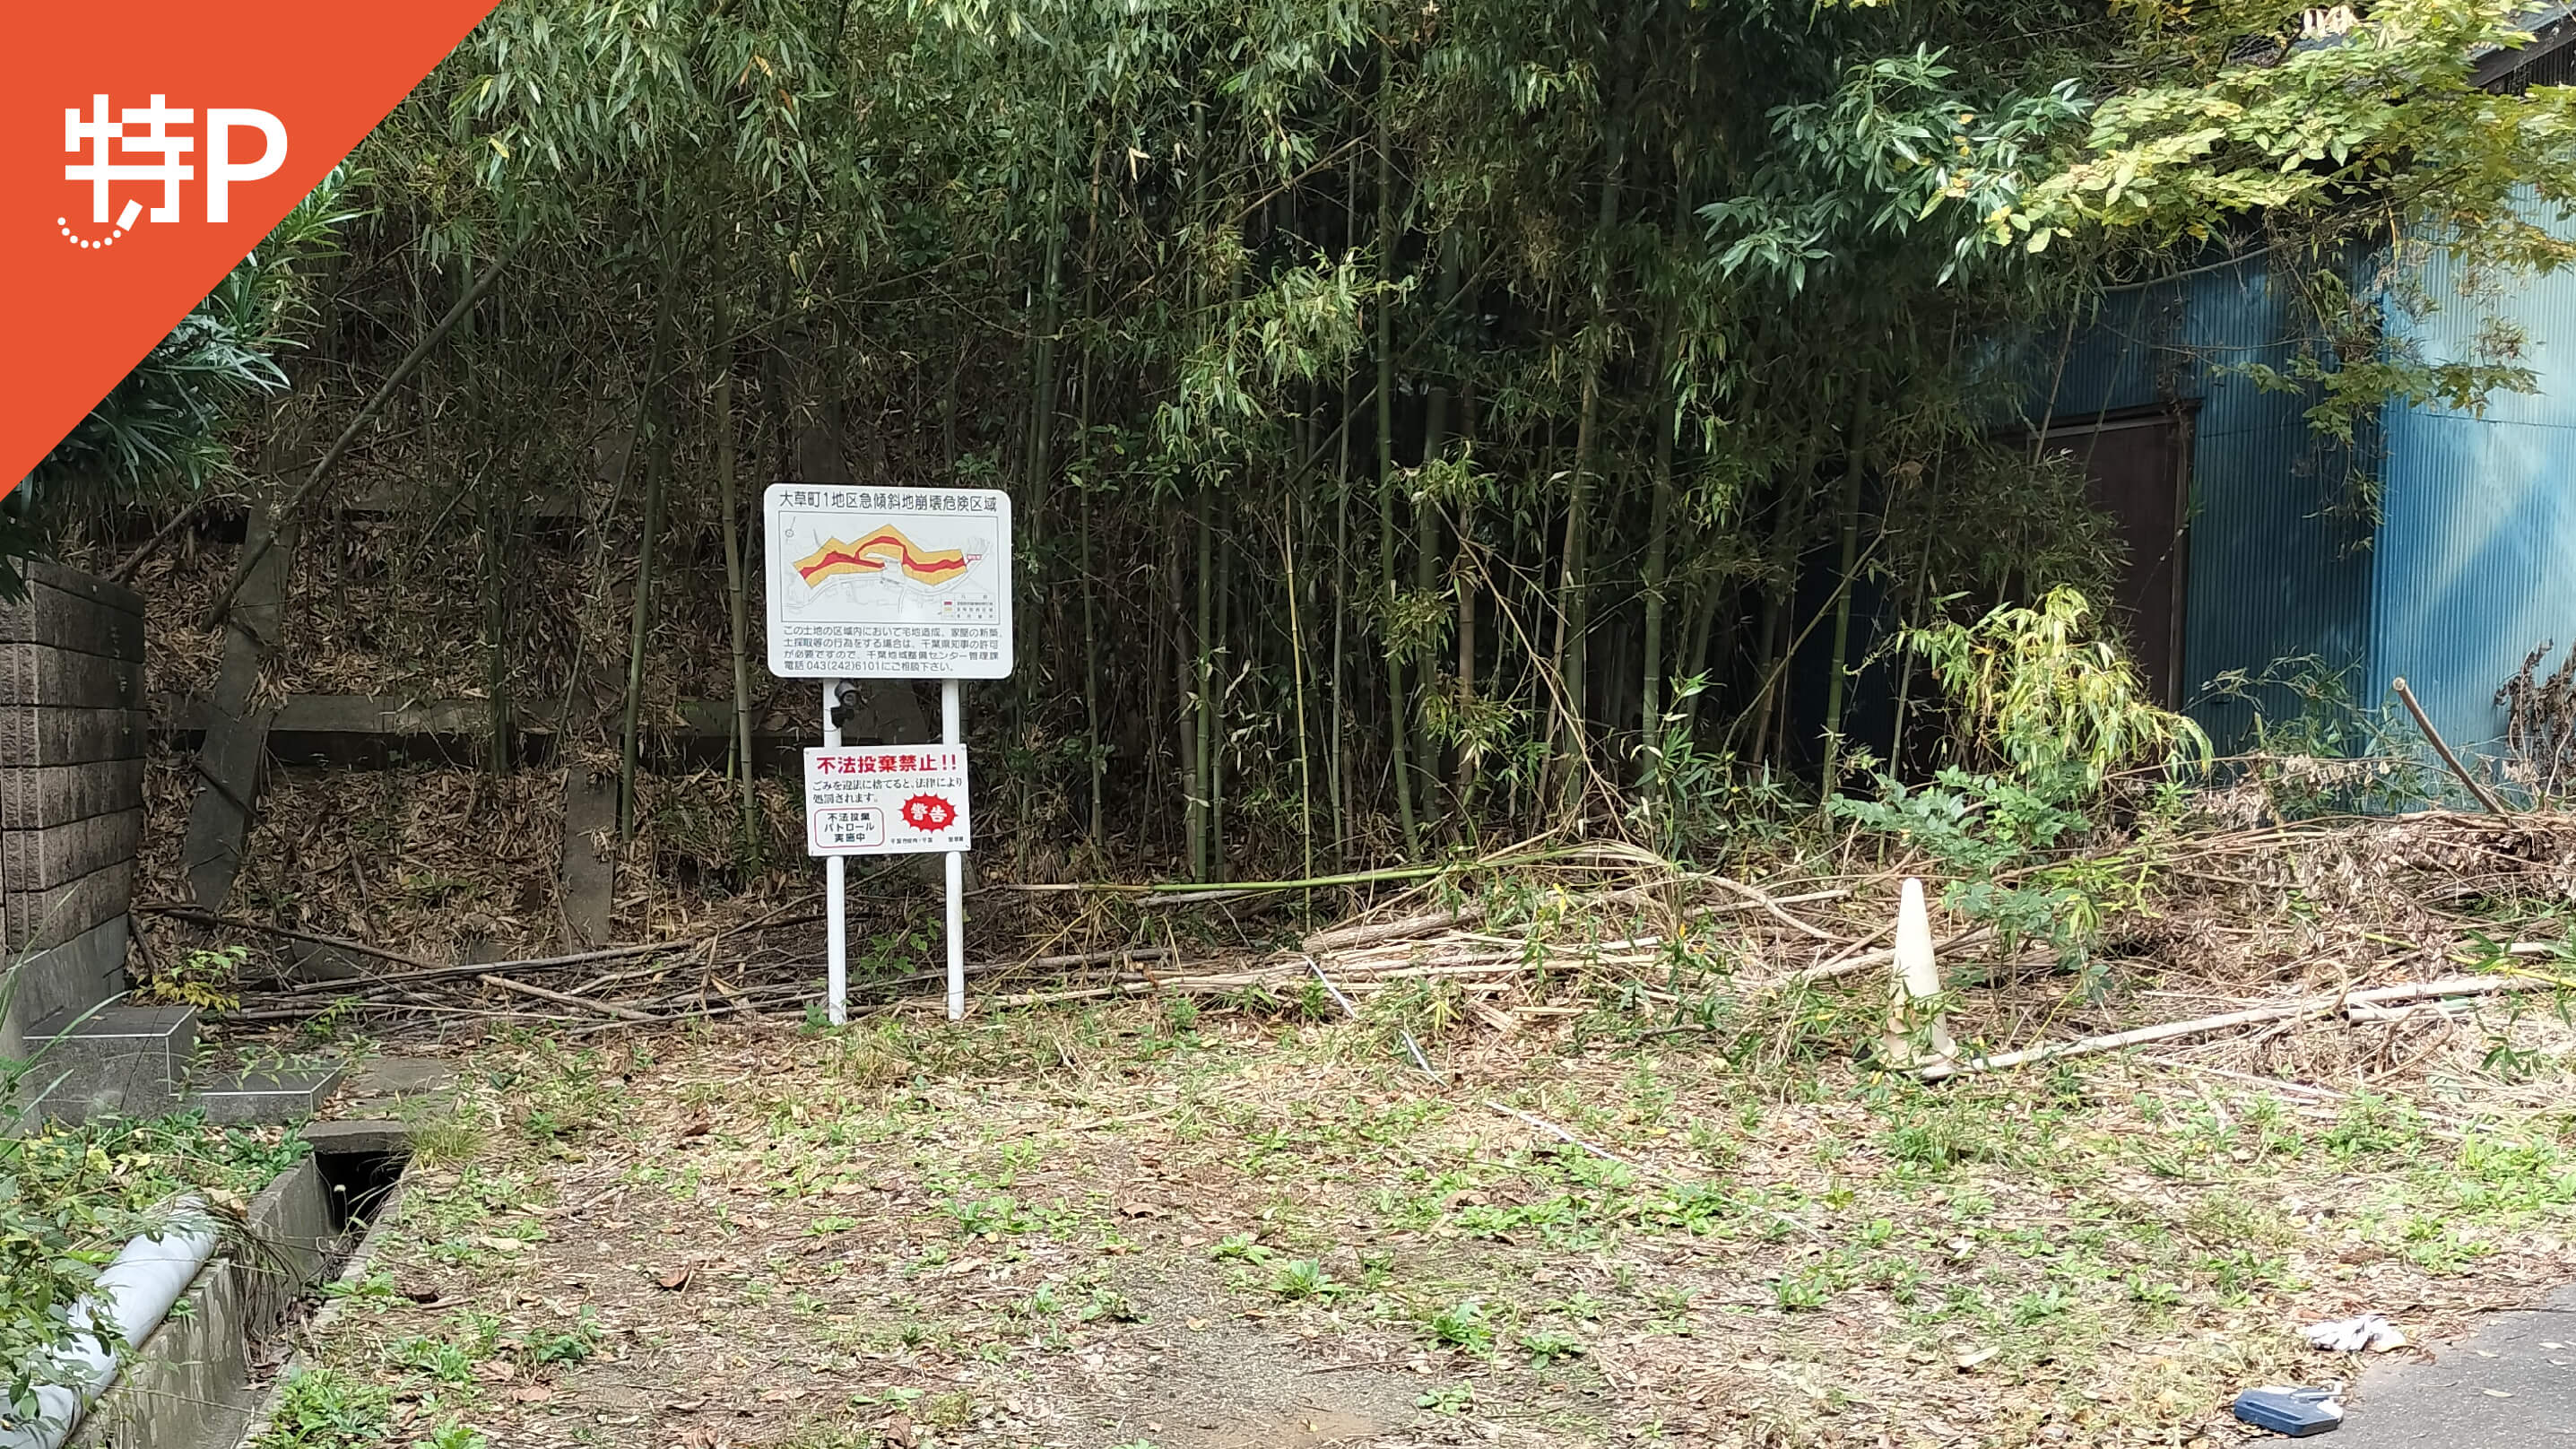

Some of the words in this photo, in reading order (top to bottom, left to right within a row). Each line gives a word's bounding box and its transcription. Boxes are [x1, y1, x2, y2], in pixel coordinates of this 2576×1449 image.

[779, 490, 998, 512] 大草町1地区急傾斜地崩壊危険区域
[827, 812, 870, 823] 不法投棄
[910, 803, 948, 823] 警告
[824, 822, 875, 832] パトロール
[834, 832, 865, 843] 実施中
